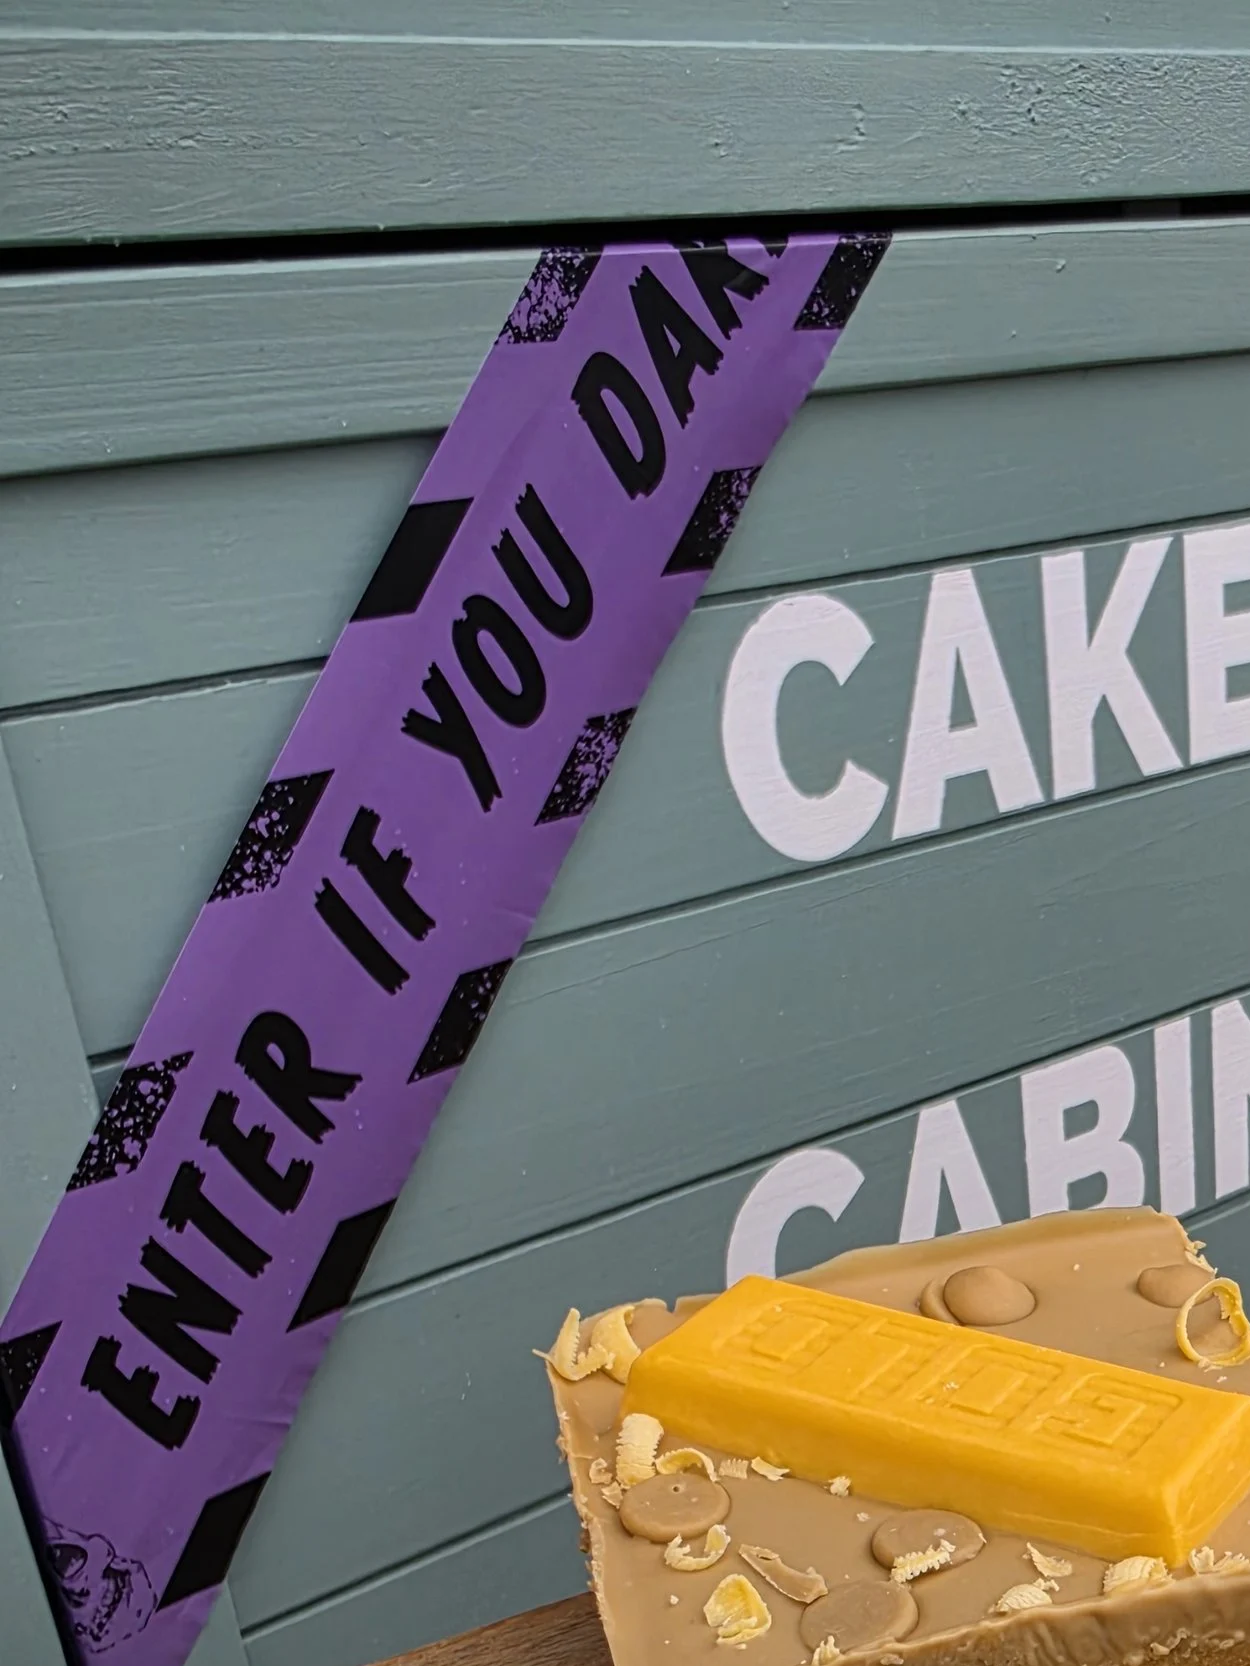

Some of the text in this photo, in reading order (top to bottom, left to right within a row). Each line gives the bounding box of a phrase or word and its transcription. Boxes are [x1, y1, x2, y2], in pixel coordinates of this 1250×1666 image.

[80, 240, 789, 1451] ENTER IF YOU DAR
